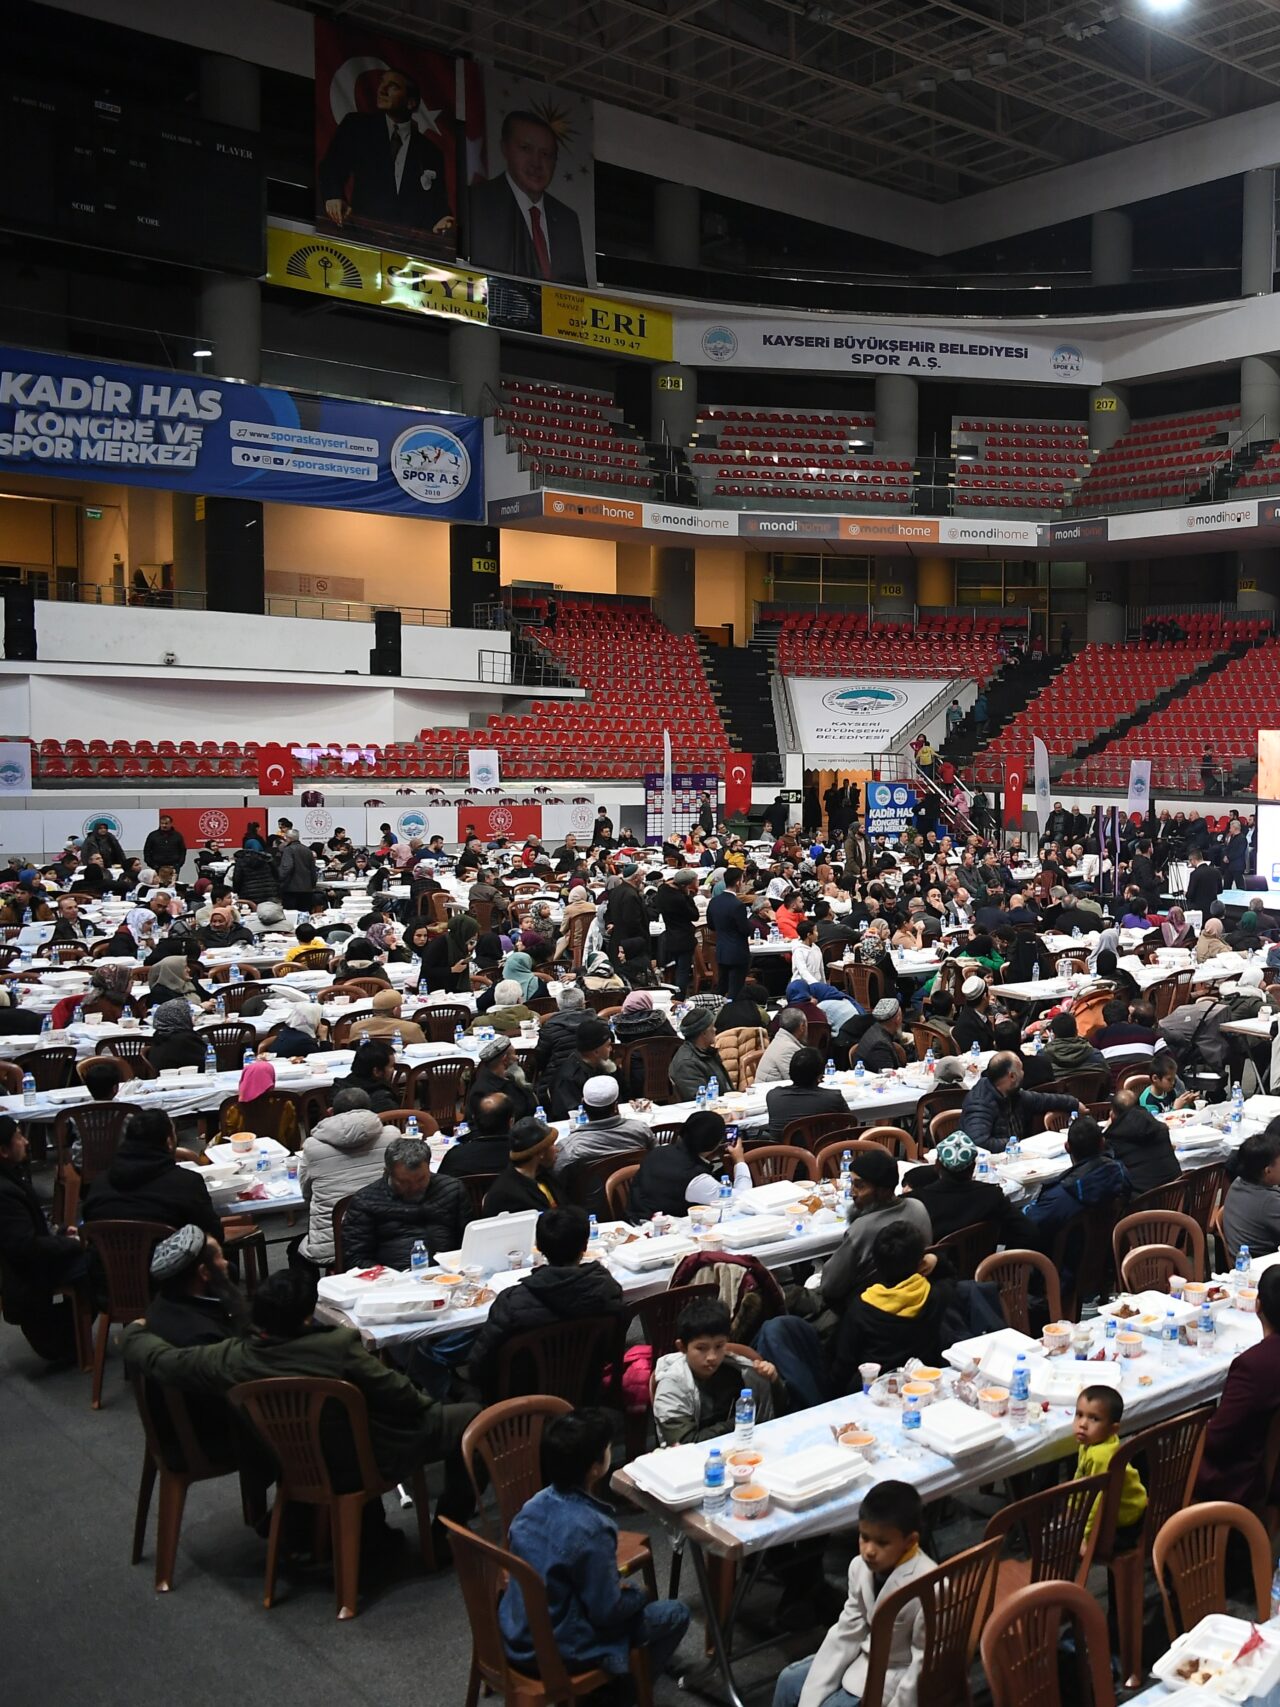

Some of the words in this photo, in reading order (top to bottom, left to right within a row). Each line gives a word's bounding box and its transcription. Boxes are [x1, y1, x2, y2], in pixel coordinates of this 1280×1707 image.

[216, 143, 253, 160] PLAYER
[72, 201, 96, 214] SCORE
[136, 215, 161, 227] SCORE
[387, 266, 487, 304] SEYİ
[593, 334, 610, 344] 220
[614, 338, 626, 347] 39
[629, 341, 640, 350] 47
[762, 334, 830, 349] KAYSERİ
[834, 335, 936, 353] BÜYÜKŞEHİR
[939, 342, 1029, 359] BELEDİYESİ
[851, 353, 900, 366] SPOR
[908, 355, 941, 370] A.Ş.
[0, 371, 131, 413] KADİR
[140, 384, 223, 421] HAS
[1096, 400, 1115, 410] 207
[14, 409, 154, 443] KONGRE
[162, 422, 204, 447] VE
[249, 429, 374, 453] www.sporaskayseri.com.tr
[0, 433, 74, 460] SPOR
[80, 438, 199, 467] MERKEZİ
[403, 470, 435, 482] SPOR
[662, 512, 729, 529] mondihome
[860, 523, 931, 537] mondihome
[959, 527, 1029, 540] mondihome
[1054, 526, 1103, 541] mondihome
[476, 561, 496, 571] 109
[882, 585, 902, 595] 108
[869, 807, 895, 819] KADİR
[896, 807, 914, 817] HAS
